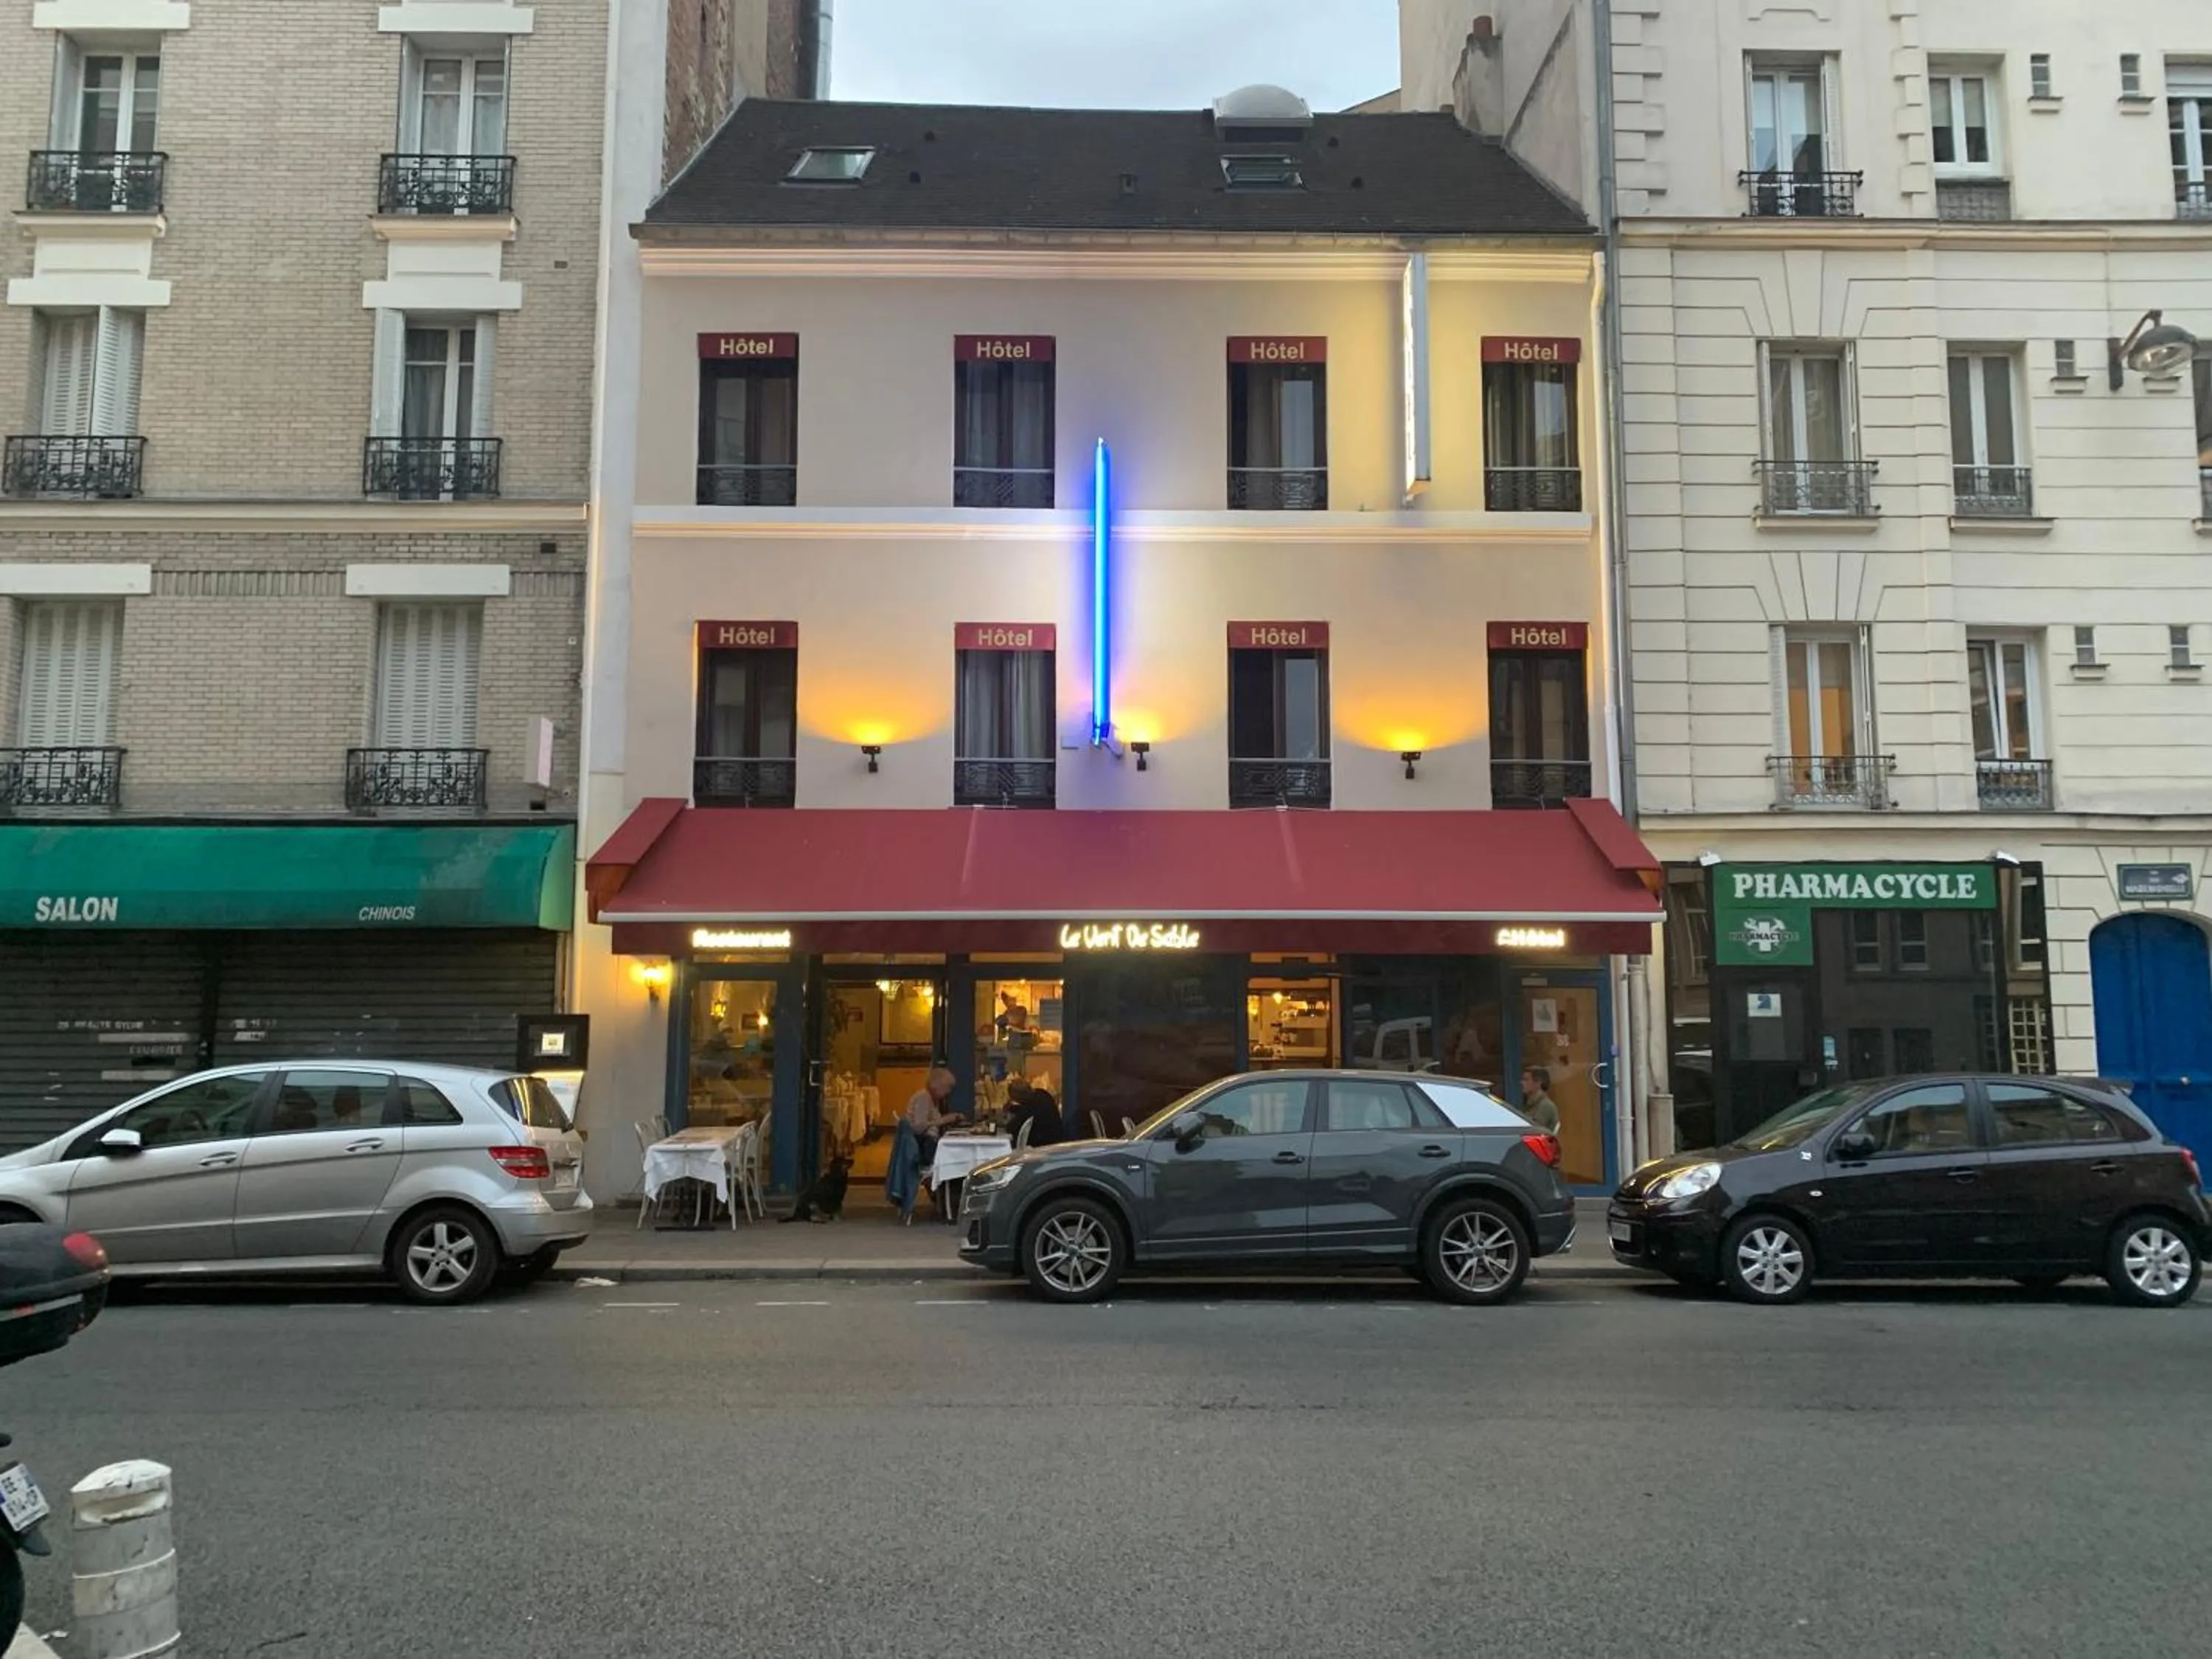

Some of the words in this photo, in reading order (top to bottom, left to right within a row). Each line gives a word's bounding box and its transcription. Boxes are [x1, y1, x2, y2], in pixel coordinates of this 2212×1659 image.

[720, 338, 773, 355] Hôtel
[977, 341, 1030, 358] Hôtel
[1251, 341, 1304, 360] Hôtel
[1504, 342, 1558, 361] Hôtel
[719, 626, 775, 645] Hôtel
[978, 628, 1033, 646] Hôtel
[1251, 627, 1306, 645] Hôtel
[1510, 627, 1567, 645] Hôtel
[1733, 873, 1977, 899] PHARMACYCLE
[35, 896, 119, 922] SALON
[358, 905, 415, 921] CHINOIS
